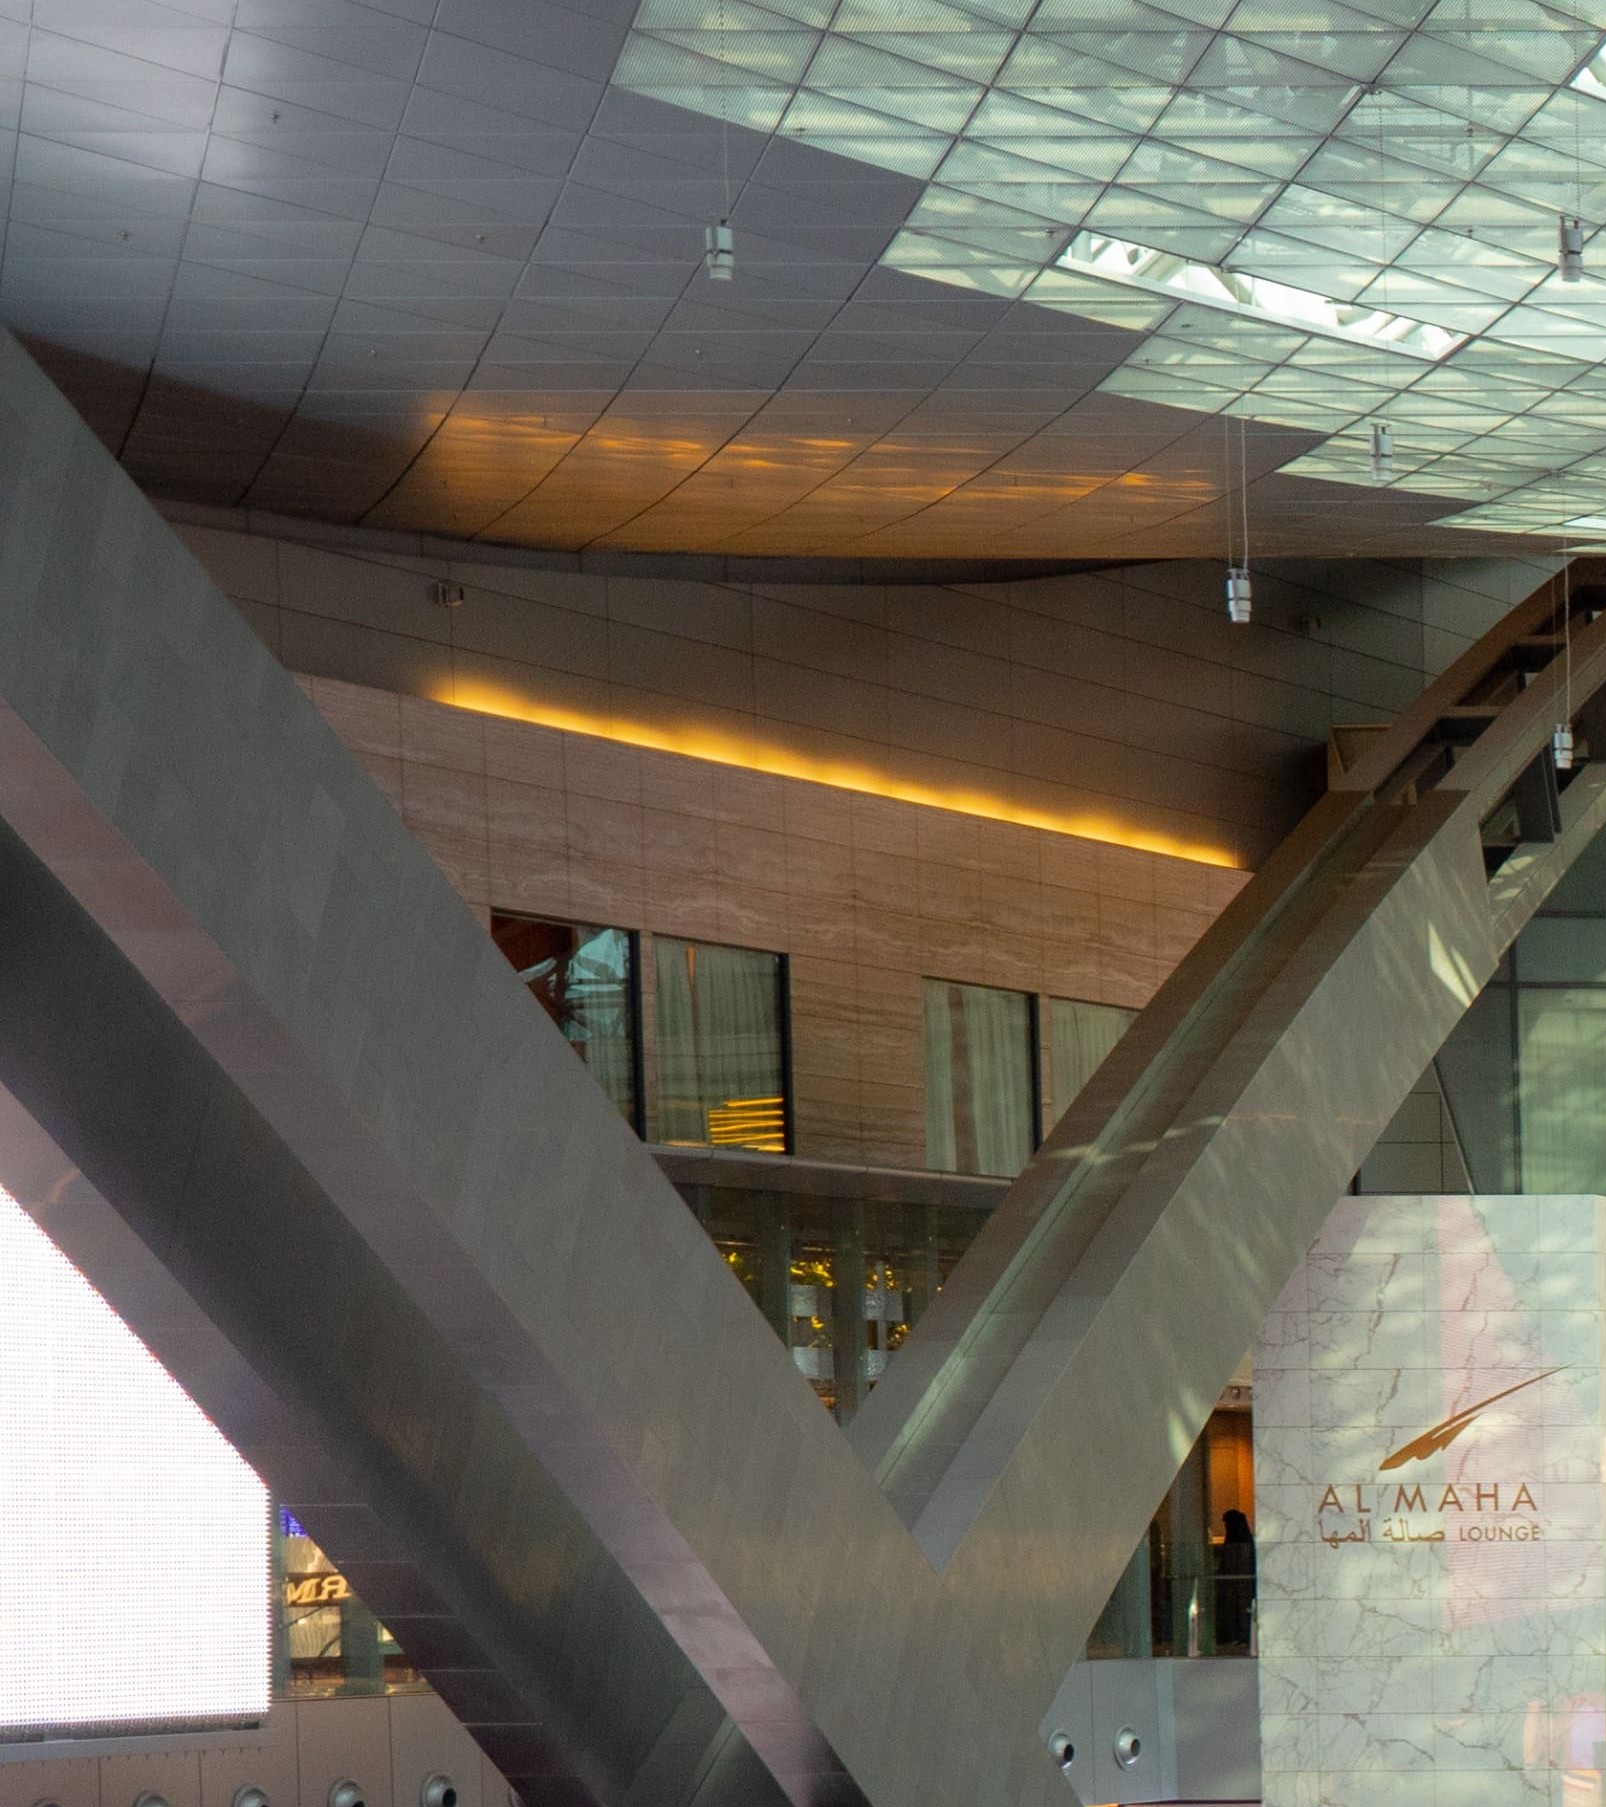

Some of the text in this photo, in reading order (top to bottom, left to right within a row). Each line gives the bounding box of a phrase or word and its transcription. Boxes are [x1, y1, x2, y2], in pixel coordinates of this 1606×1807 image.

[1318, 1482, 1538, 1513] AL MAHA
[1318, 1517, 1446, 1550] صالة المها
[1459, 1525, 1541, 1542] LOUNGE
